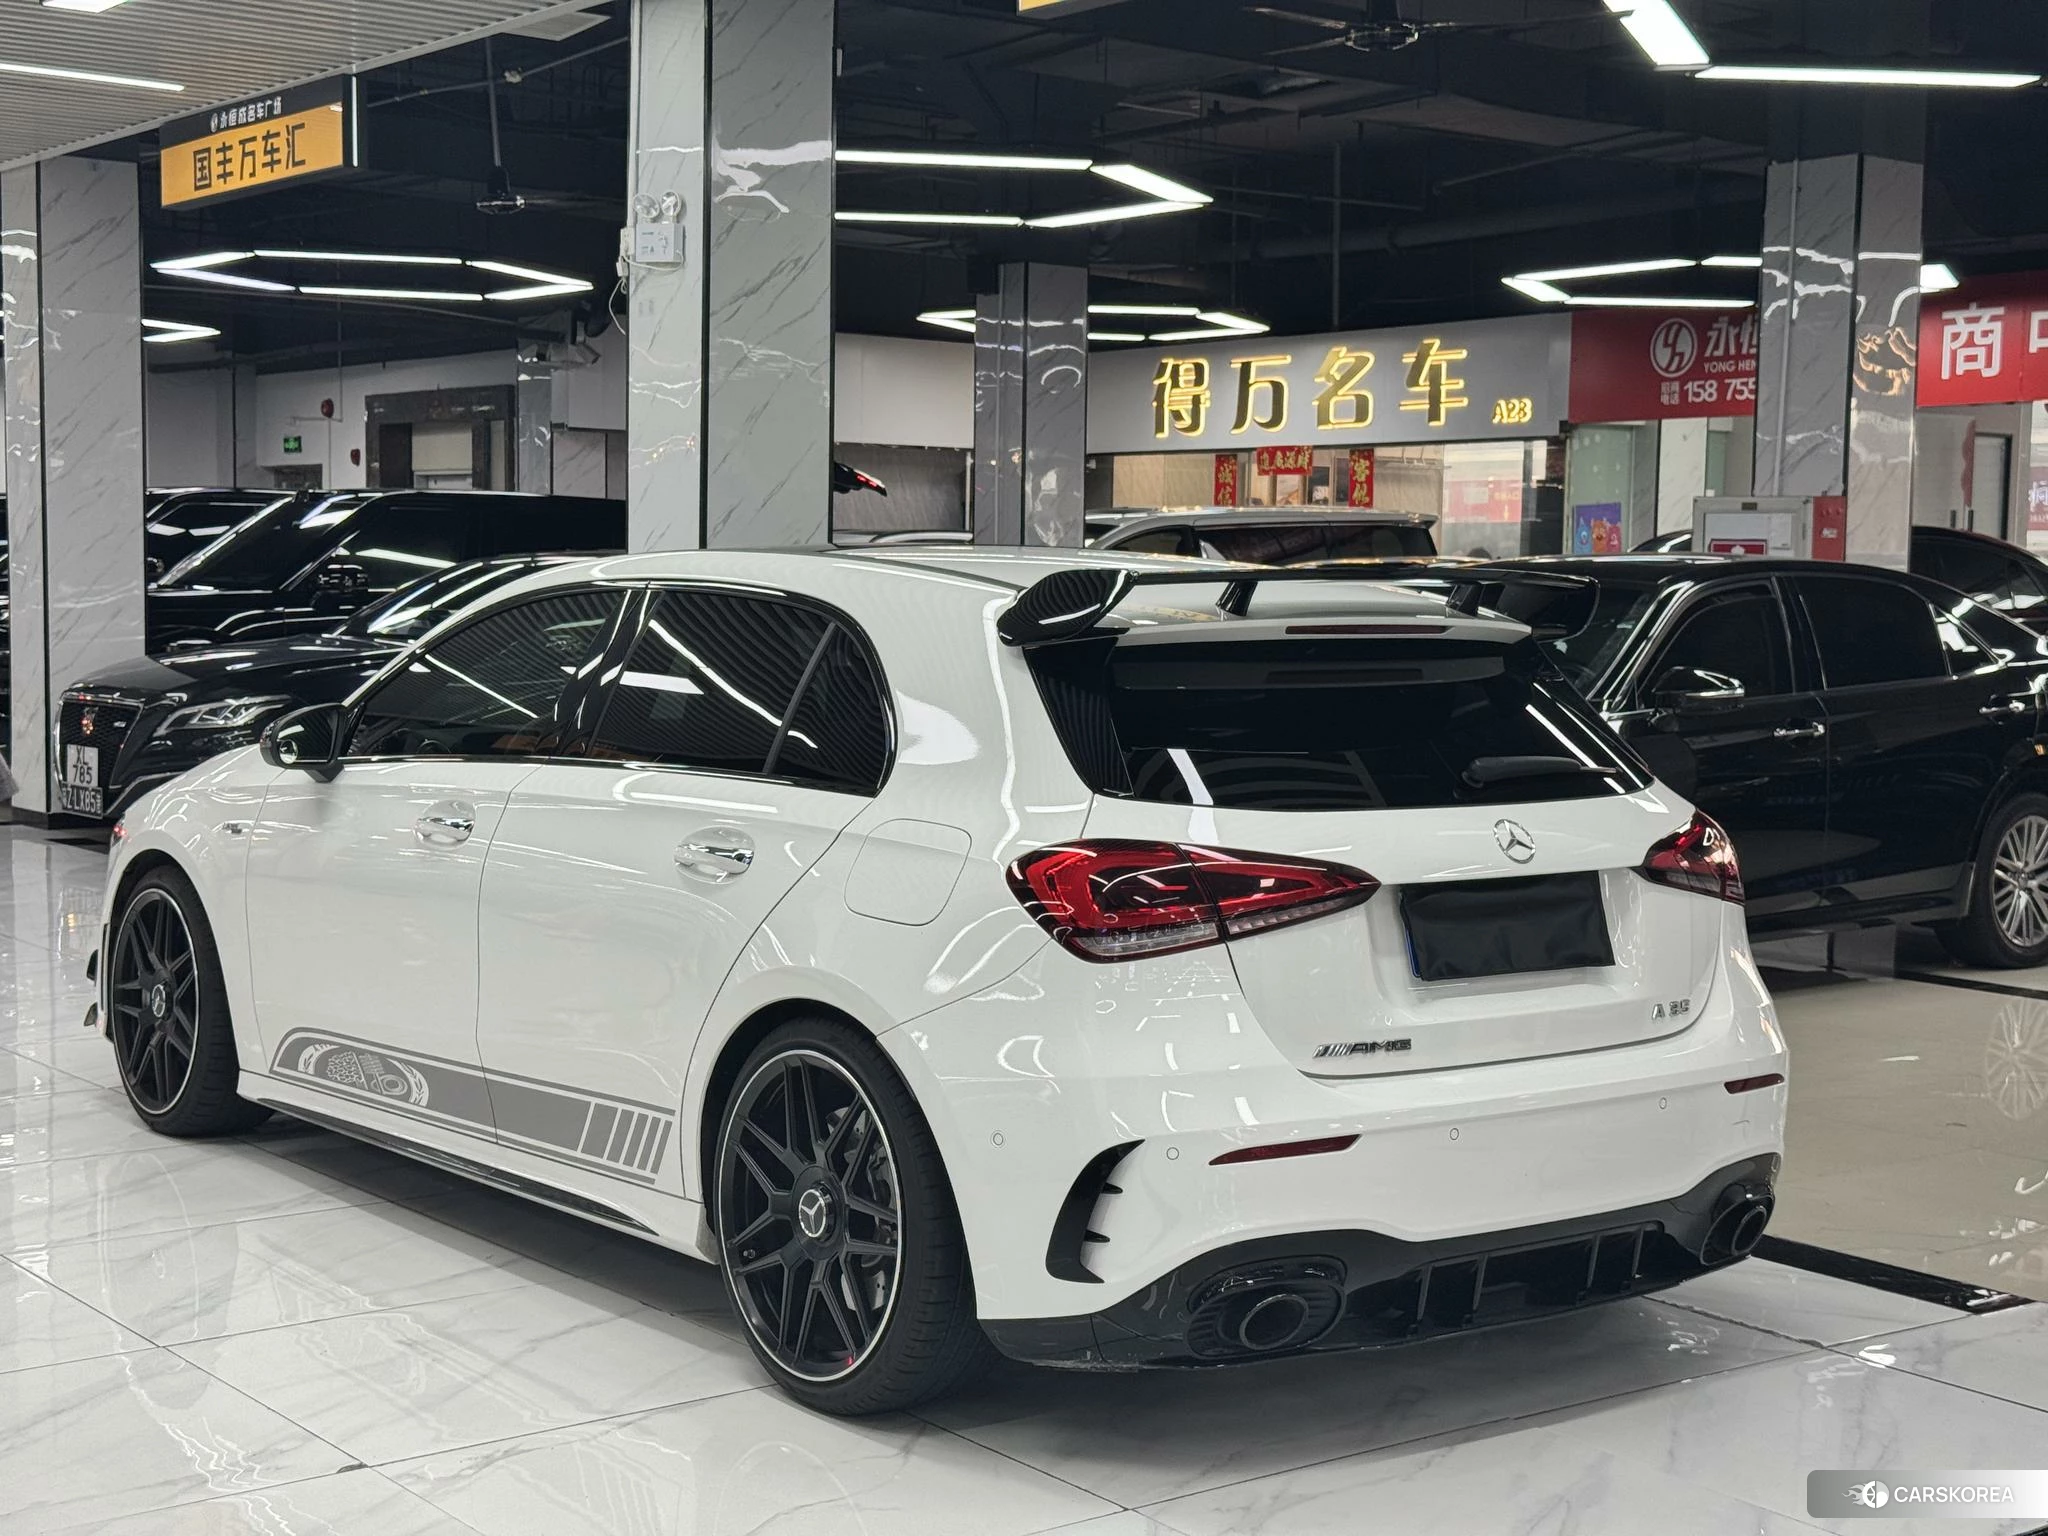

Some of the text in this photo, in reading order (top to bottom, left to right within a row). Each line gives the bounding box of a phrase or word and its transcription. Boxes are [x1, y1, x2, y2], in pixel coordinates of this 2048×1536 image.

[193, 122, 306, 192] 国丰万车汇
[1704, 361, 1736, 373] YONG
[1152, 338, 1469, 438] 得万名车
[1684, 380, 1718, 403] 158
[1492, 398, 1532, 424] A23
[72, 764, 93, 785] 785
[1651, 1003, 1666, 1020] A
